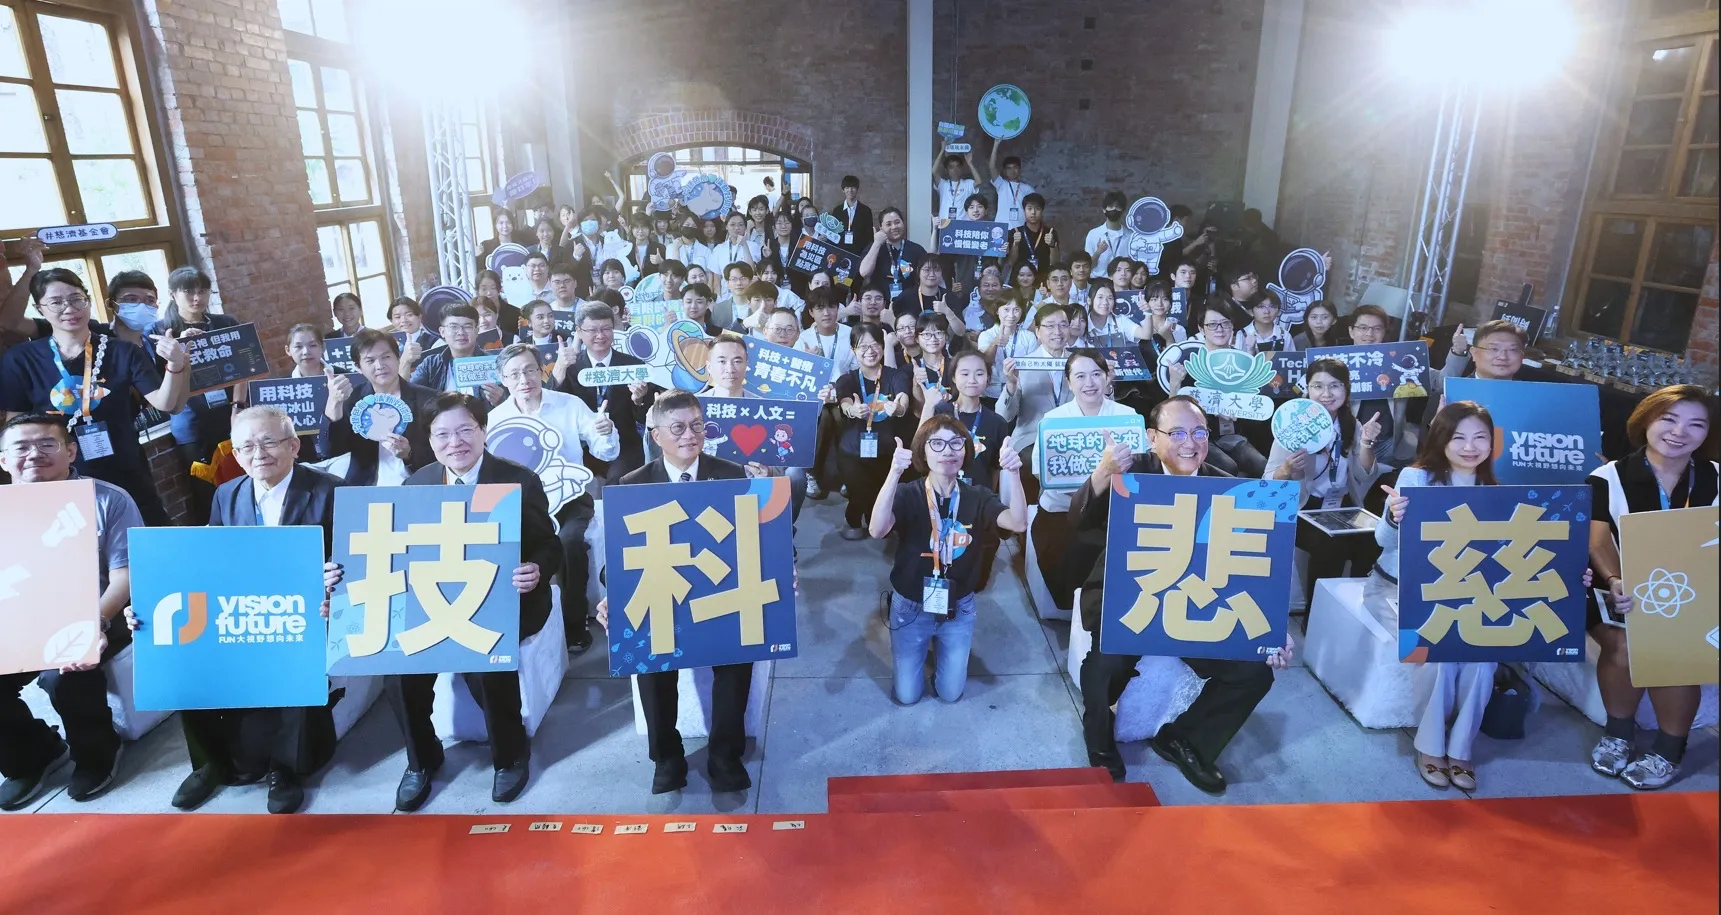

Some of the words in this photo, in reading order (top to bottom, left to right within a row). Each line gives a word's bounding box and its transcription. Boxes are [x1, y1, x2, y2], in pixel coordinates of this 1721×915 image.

[45, 226, 110, 240] #慈濟基金會
[954, 229, 989, 240] 科技陪你
[803, 240, 827, 256] 用科技
[953, 239, 988, 250] 慢慢變老
[210, 330, 241, 346] 但我用
[584, 367, 650, 384] #慈濟大學
[753, 361, 817, 393] 青春不凡
[259, 383, 314, 402] 用科技
[1218, 407, 1267, 419] UNIVERSITY
[1511, 430, 1585, 450] vision
[1509, 443, 1586, 465] future
[622, 493, 780, 655] 科
[1119, 493, 1276, 643] 悲
[1416, 502, 1570, 647] 慈
[345, 501, 503, 658] 技
[216, 594, 306, 615] vision
[214, 612, 307, 635] future
